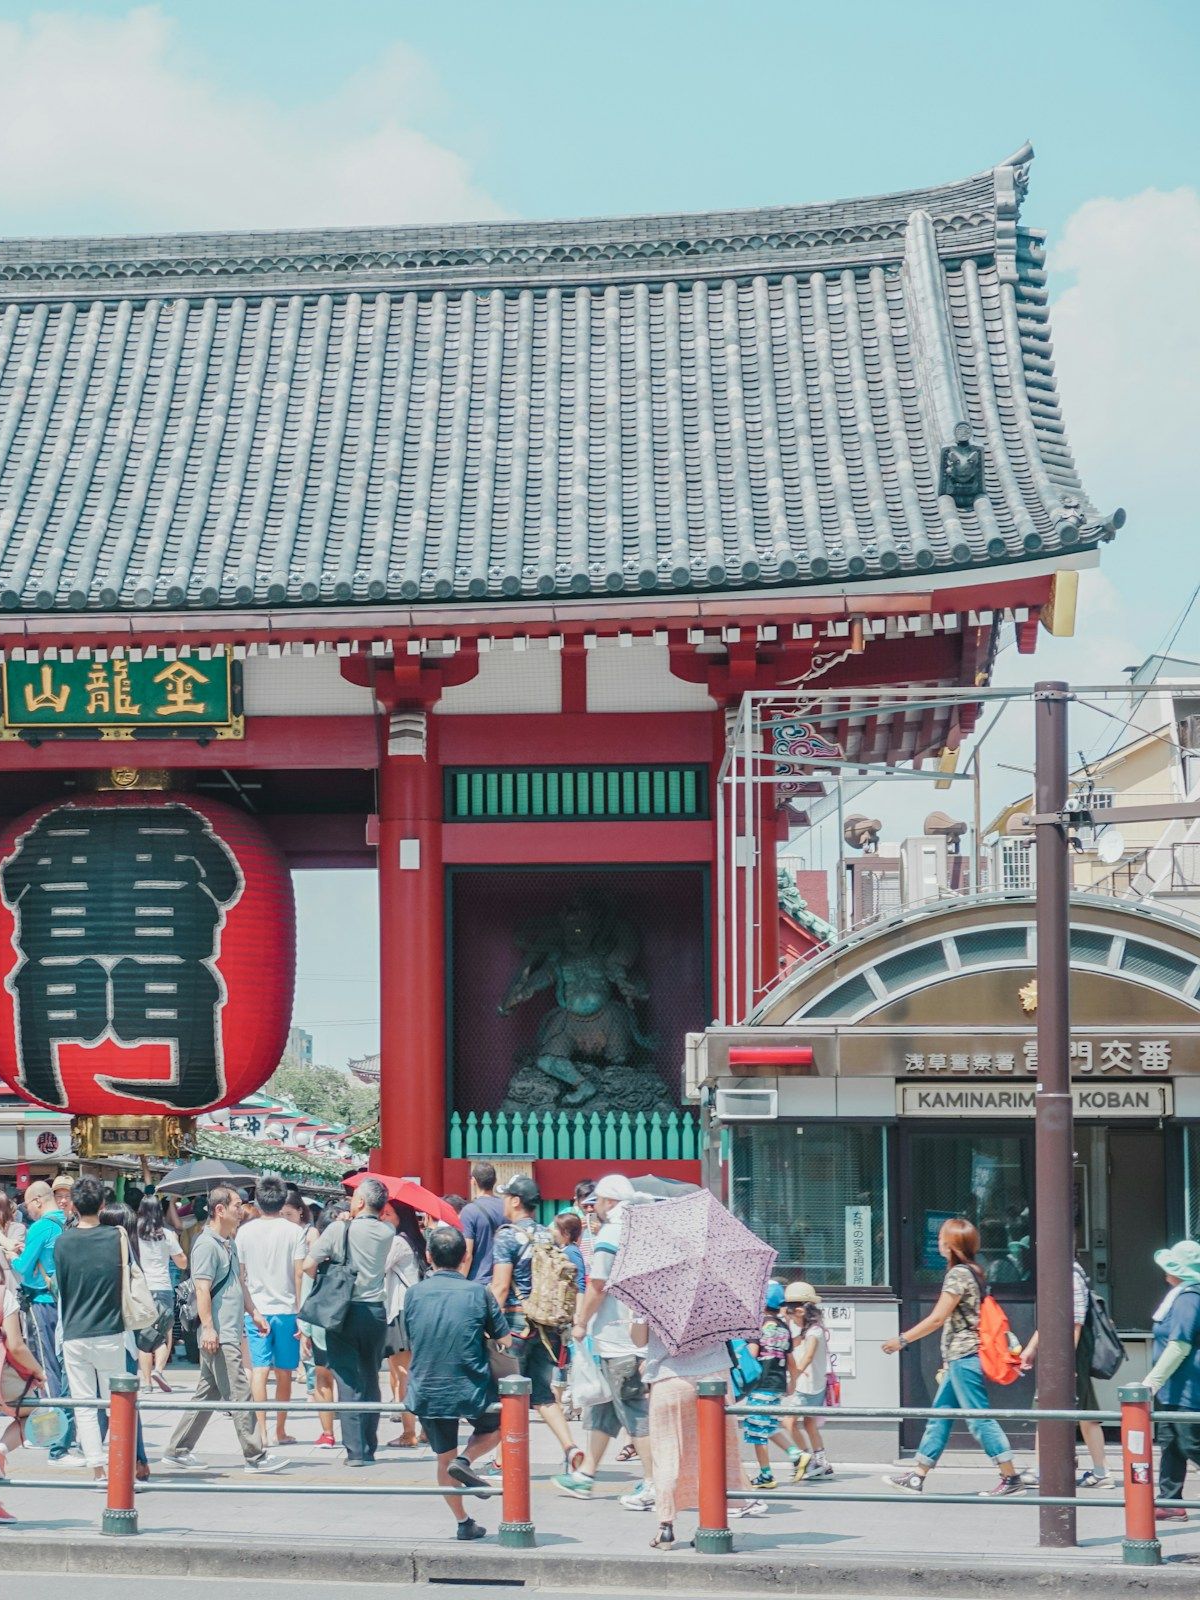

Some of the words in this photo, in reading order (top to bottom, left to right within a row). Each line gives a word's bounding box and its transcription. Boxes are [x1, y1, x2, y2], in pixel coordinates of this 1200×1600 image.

[905, 1053, 1015, 1073] 浅草警察署
[918, 1092, 1037, 1109] KAMINARIM
[1079, 1091, 1150, 1108] KOBAN
